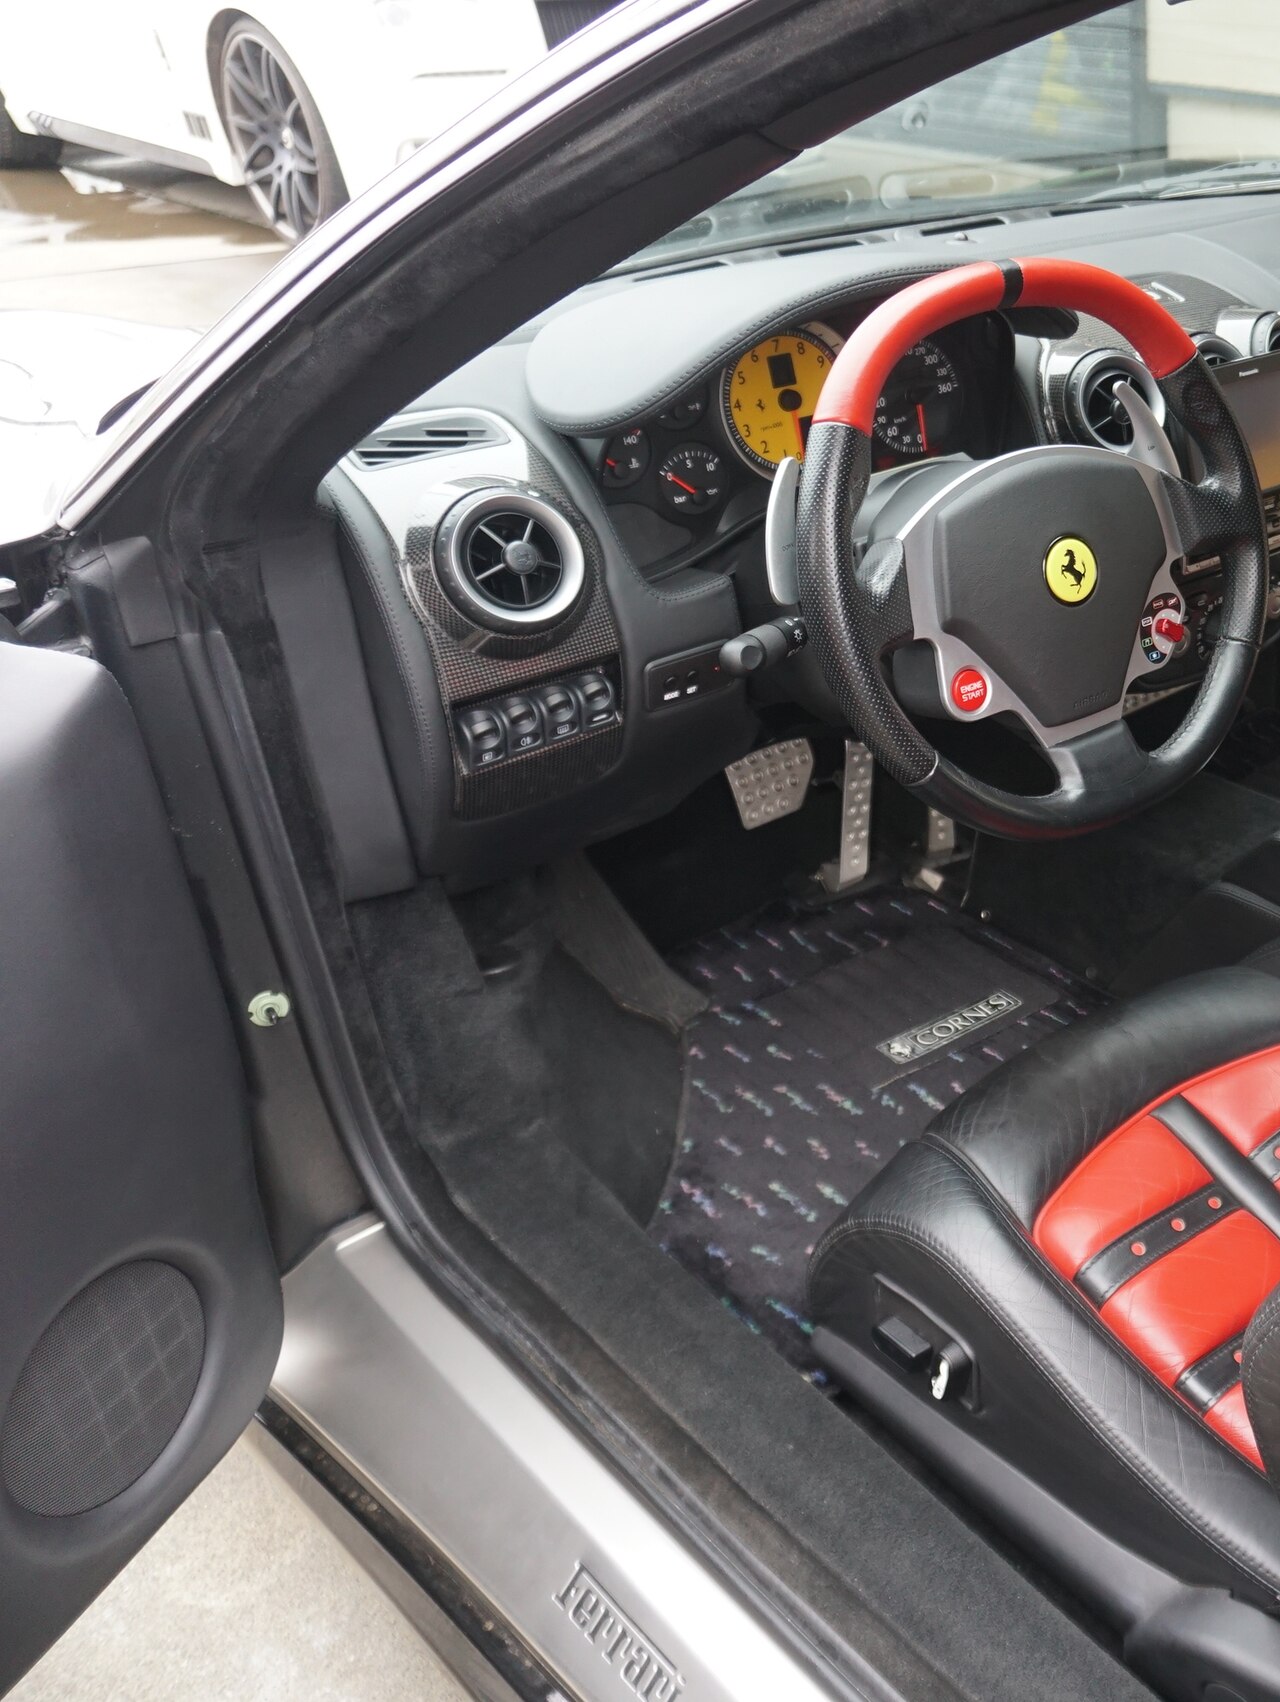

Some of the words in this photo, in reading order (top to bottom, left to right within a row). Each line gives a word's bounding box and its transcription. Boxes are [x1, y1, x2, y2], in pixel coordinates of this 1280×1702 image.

[771, 338, 779, 352] 7
[796, 342, 805, 355] 8
[915, 346, 926, 356] 270
[751, 350, 759, 363] 6
[816, 355, 825, 368] 9
[924, 354, 938, 366] 300
[737, 371, 745, 385] 5
[936, 367, 948, 377] 330
[937, 382, 952, 394] 360
[733, 398, 742, 412] 4
[875, 397, 886, 408] 20
[877, 415, 886, 424] 90
[743, 424, 751, 438] 3
[887, 426, 898, 437] 60
[623, 434, 637, 446] 140
[902, 435, 911, 444] 30
[916, 434, 923, 444] 0
[760, 440, 770, 454] 2
[685, 459, 692, 469] 5
[705, 463, 715, 472] 10
[673, 495, 687, 504] bar
[960, 680, 984, 694] ENGINE
[961, 689, 985, 702] START
[916, 997, 1008, 1046] CORNES
[551, 1559, 686, 1702] Ferrari
